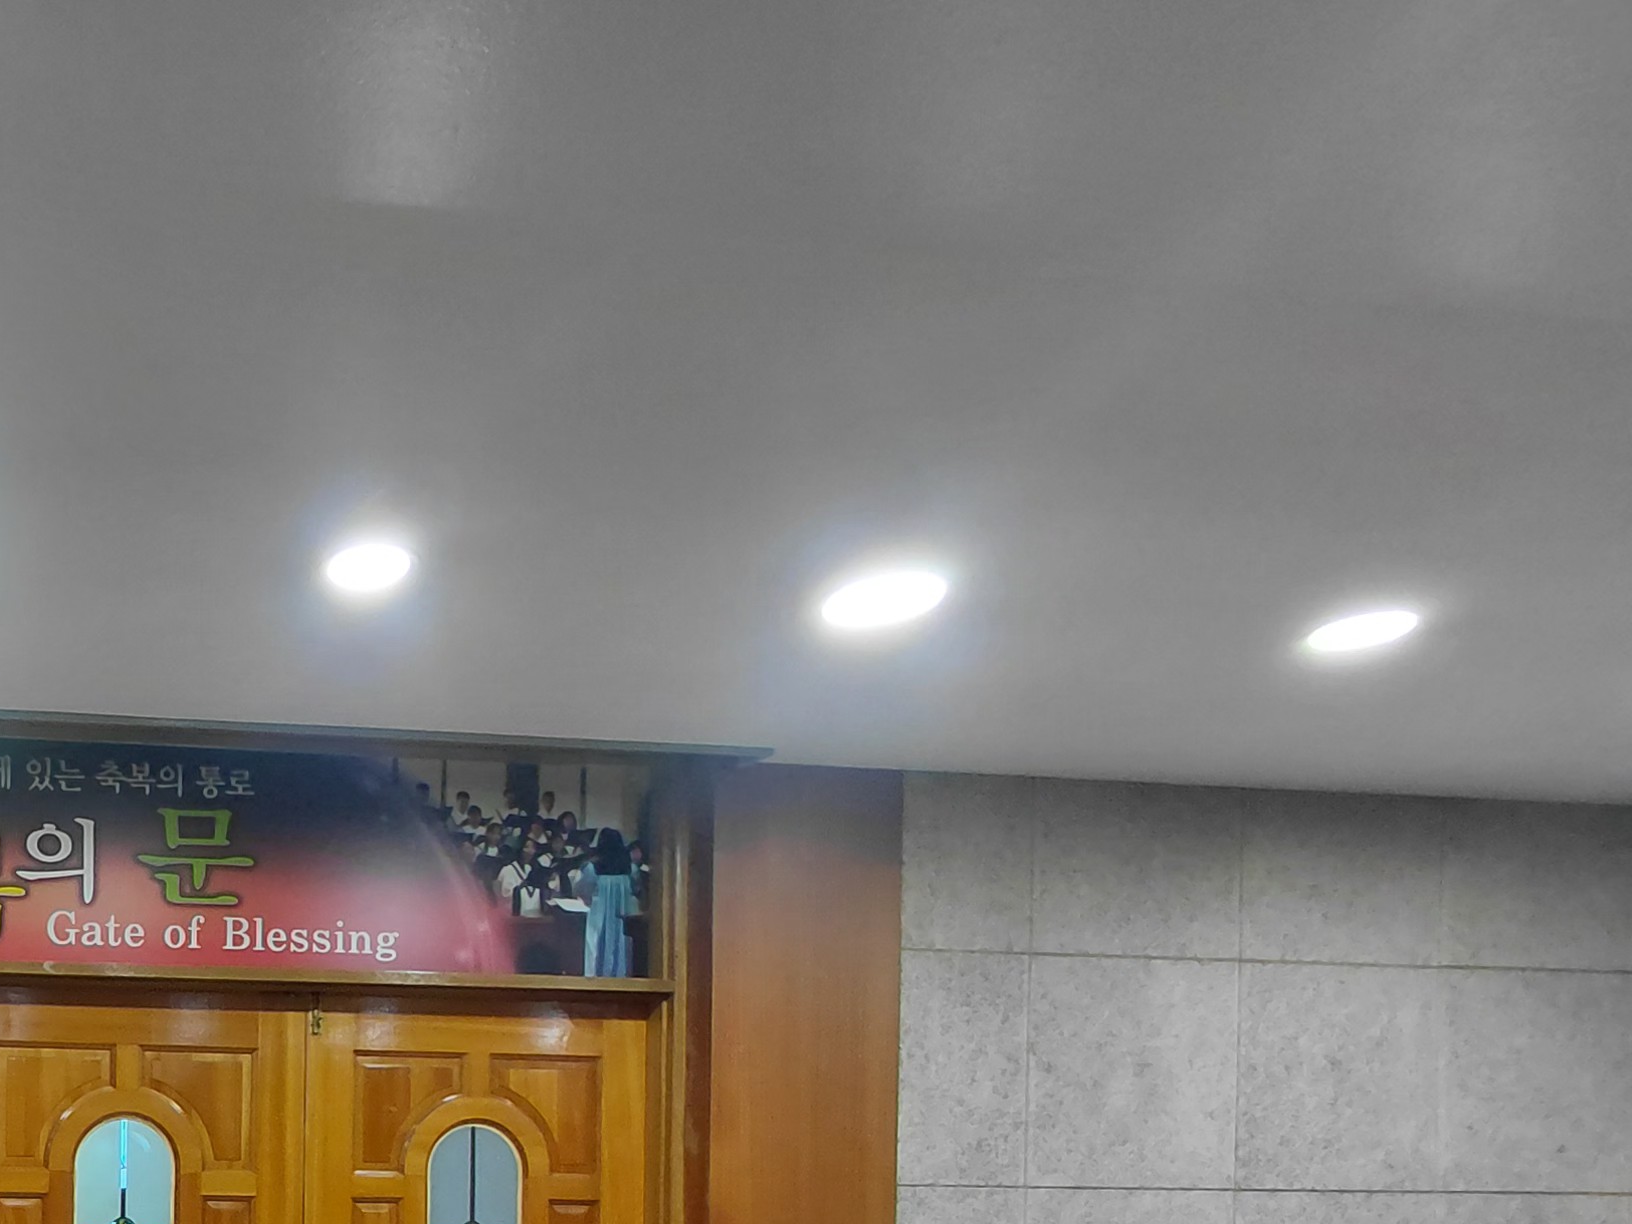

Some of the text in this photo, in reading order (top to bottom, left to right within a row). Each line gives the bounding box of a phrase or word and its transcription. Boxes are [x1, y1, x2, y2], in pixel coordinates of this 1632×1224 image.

[26, 756, 86, 792] 있는
[95, 760, 183, 798] 축복의
[195, 765, 256, 799] 통로
[137, 808, 256, 906] 문
[46, 909, 400, 962] Gate of Blessing
